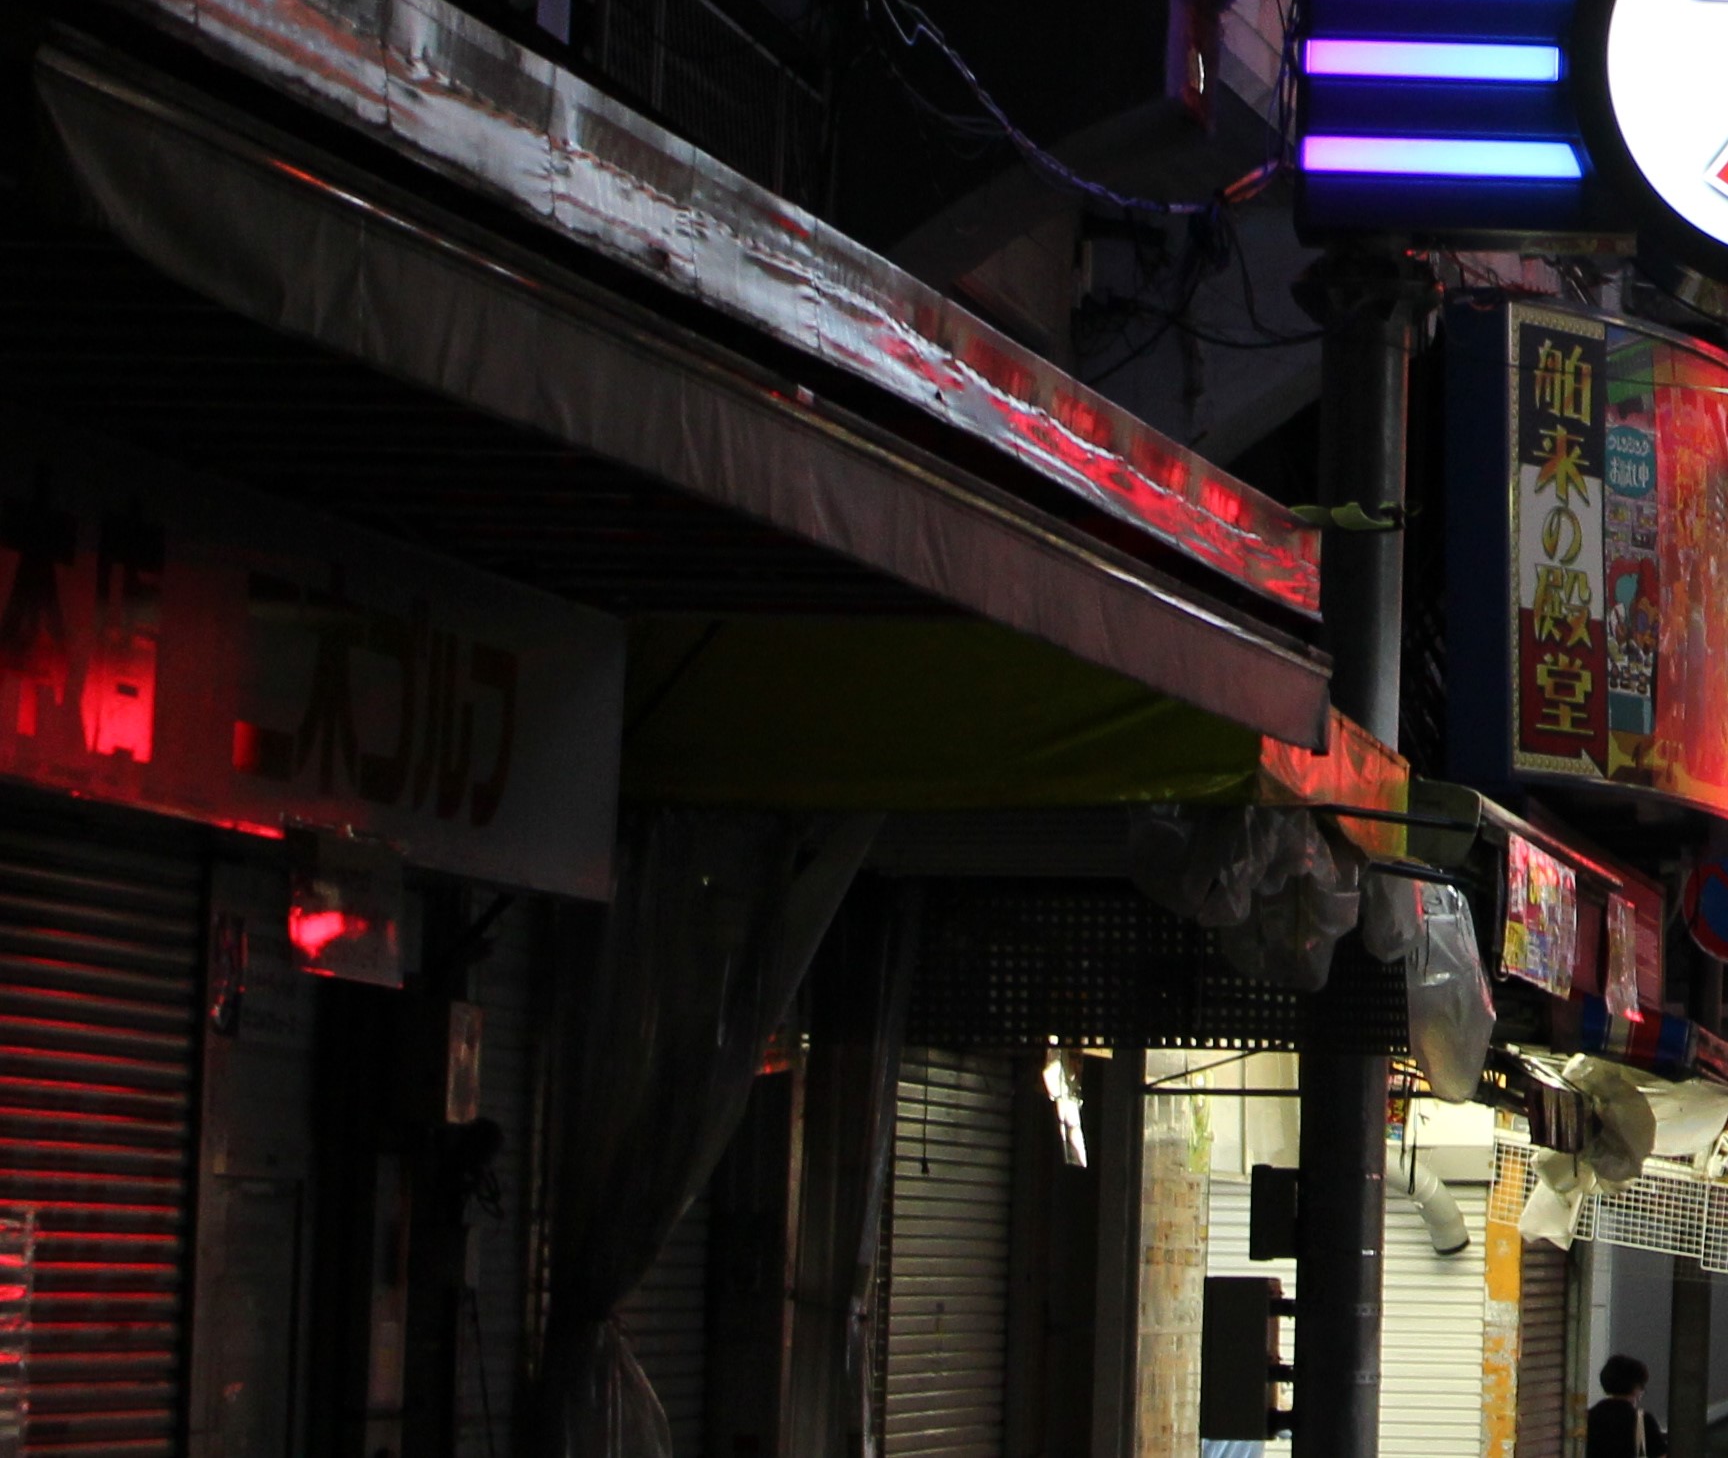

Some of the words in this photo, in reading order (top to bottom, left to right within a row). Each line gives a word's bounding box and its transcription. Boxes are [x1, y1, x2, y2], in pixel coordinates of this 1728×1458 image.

[1532, 338, 1596, 738] 舶来の殿堂
